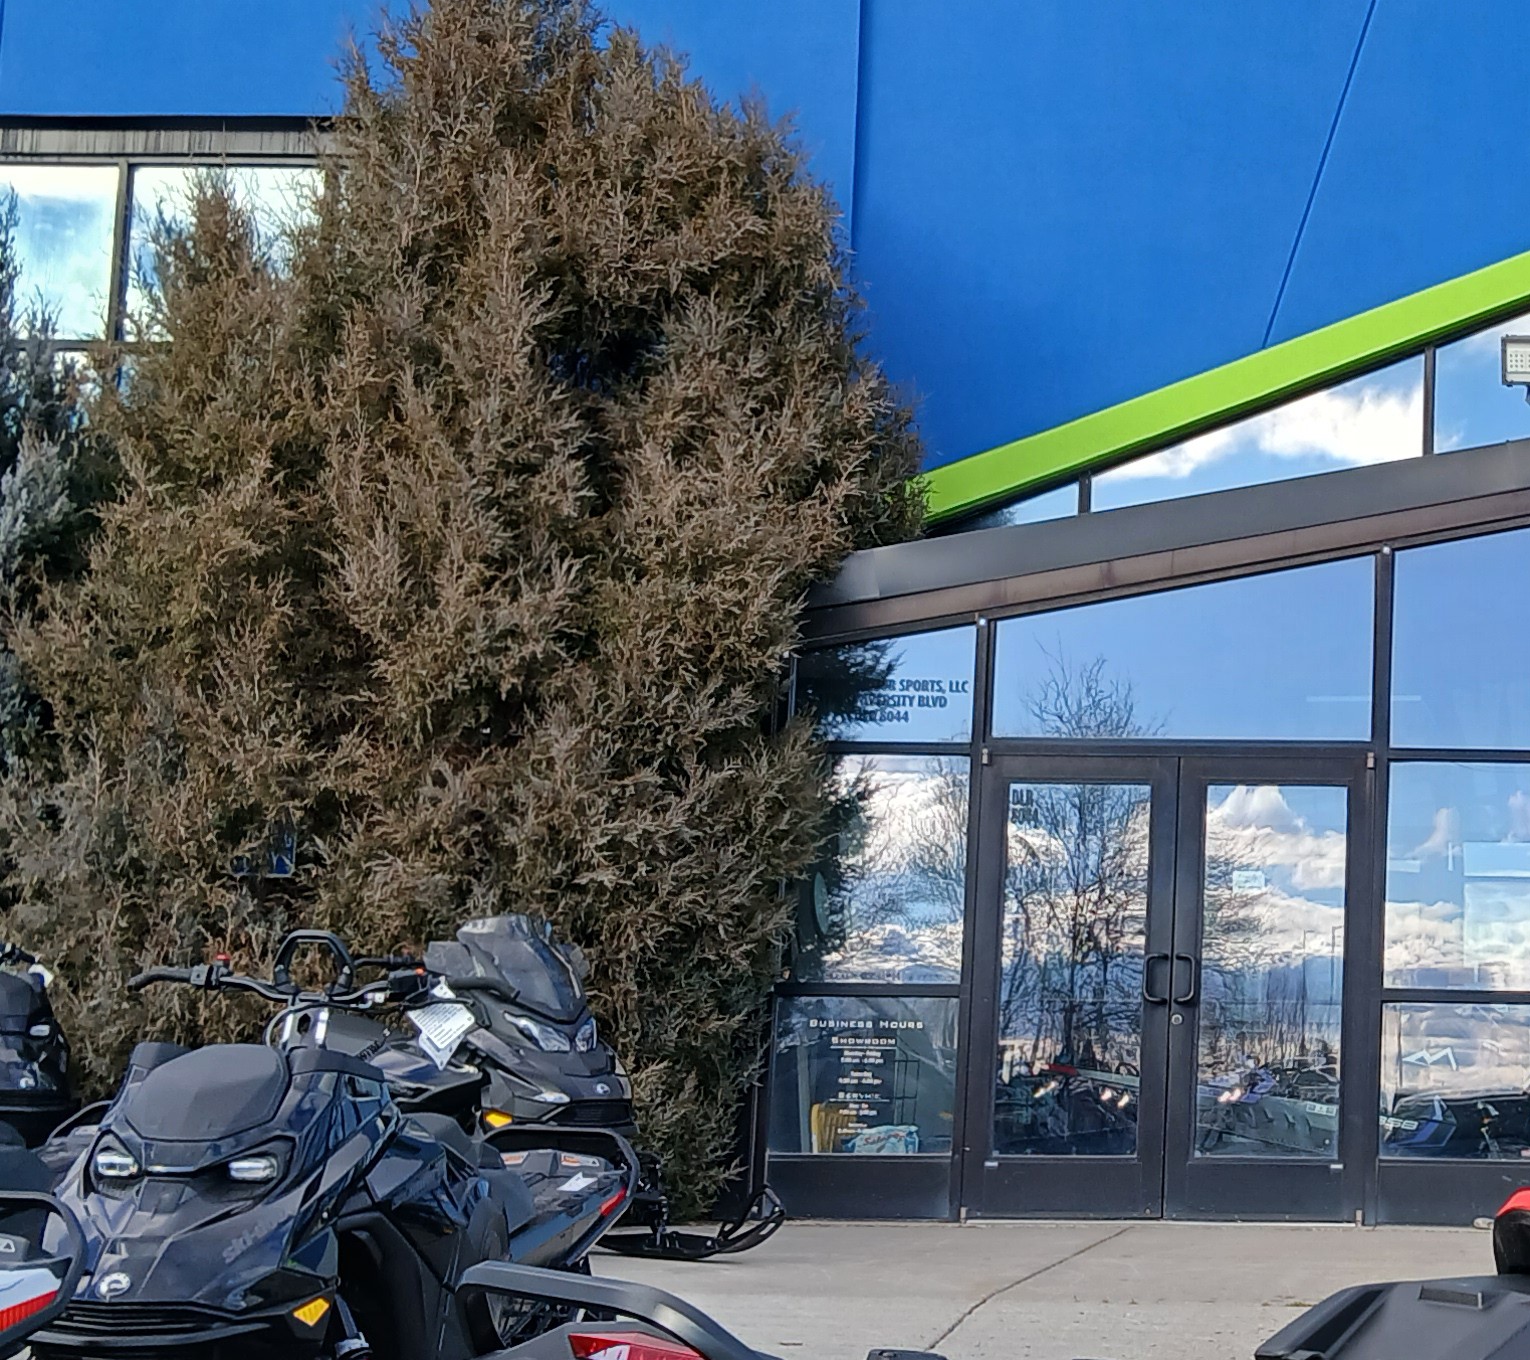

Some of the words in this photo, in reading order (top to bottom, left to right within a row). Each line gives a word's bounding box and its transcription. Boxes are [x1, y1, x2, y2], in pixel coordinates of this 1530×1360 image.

[899, 678, 945, 694] SPORTS,
[948, 680, 969, 693] LLC
[917, 695, 947, 707] BLVD
